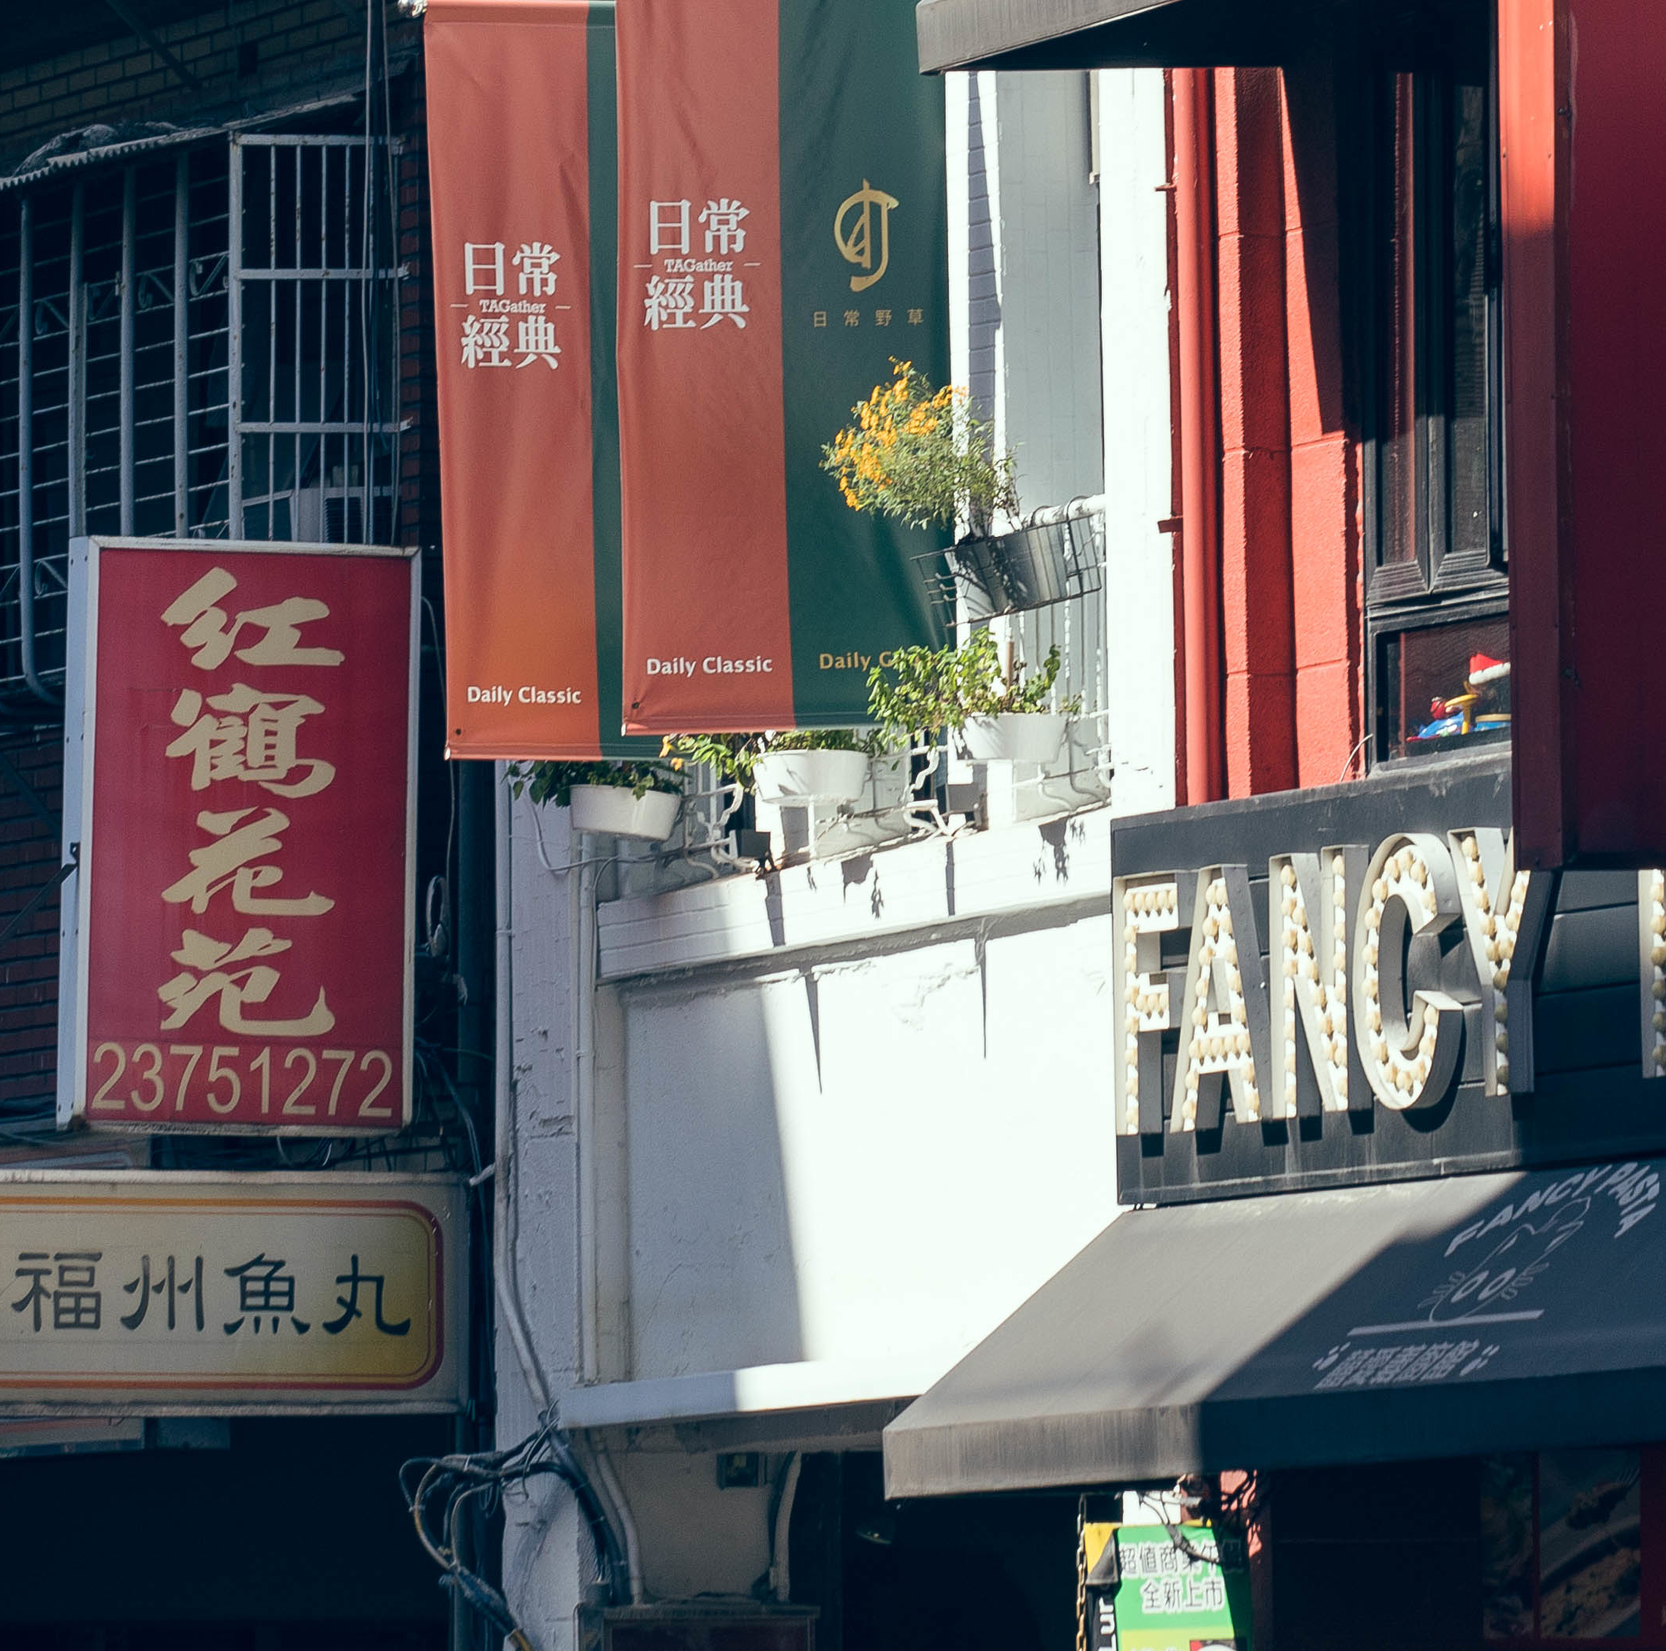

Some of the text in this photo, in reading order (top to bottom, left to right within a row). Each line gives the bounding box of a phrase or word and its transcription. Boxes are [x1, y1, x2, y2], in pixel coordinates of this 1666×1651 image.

[648, 198, 751, 254] 日常
[463, 241, 560, 296] 日常
[664, 258, 734, 274] TAGather
[479, 298, 547, 315] TAGather
[644, 275, 751, 332] 經典
[813, 309, 925, 328] 日常野草
[460, 314, 562, 371] 經典
[646, 655, 774, 679] Daily Classic
[819, 651, 871, 676] Daily
[467, 685, 583, 709] Daily Classic
[1114, 826, 1530, 1136] FANCY
[90, 1041, 394, 1118] 23751272
[1443, 1164, 1613, 1257] FANCY
[1142, 1578, 1224, 1611] 全新上市
